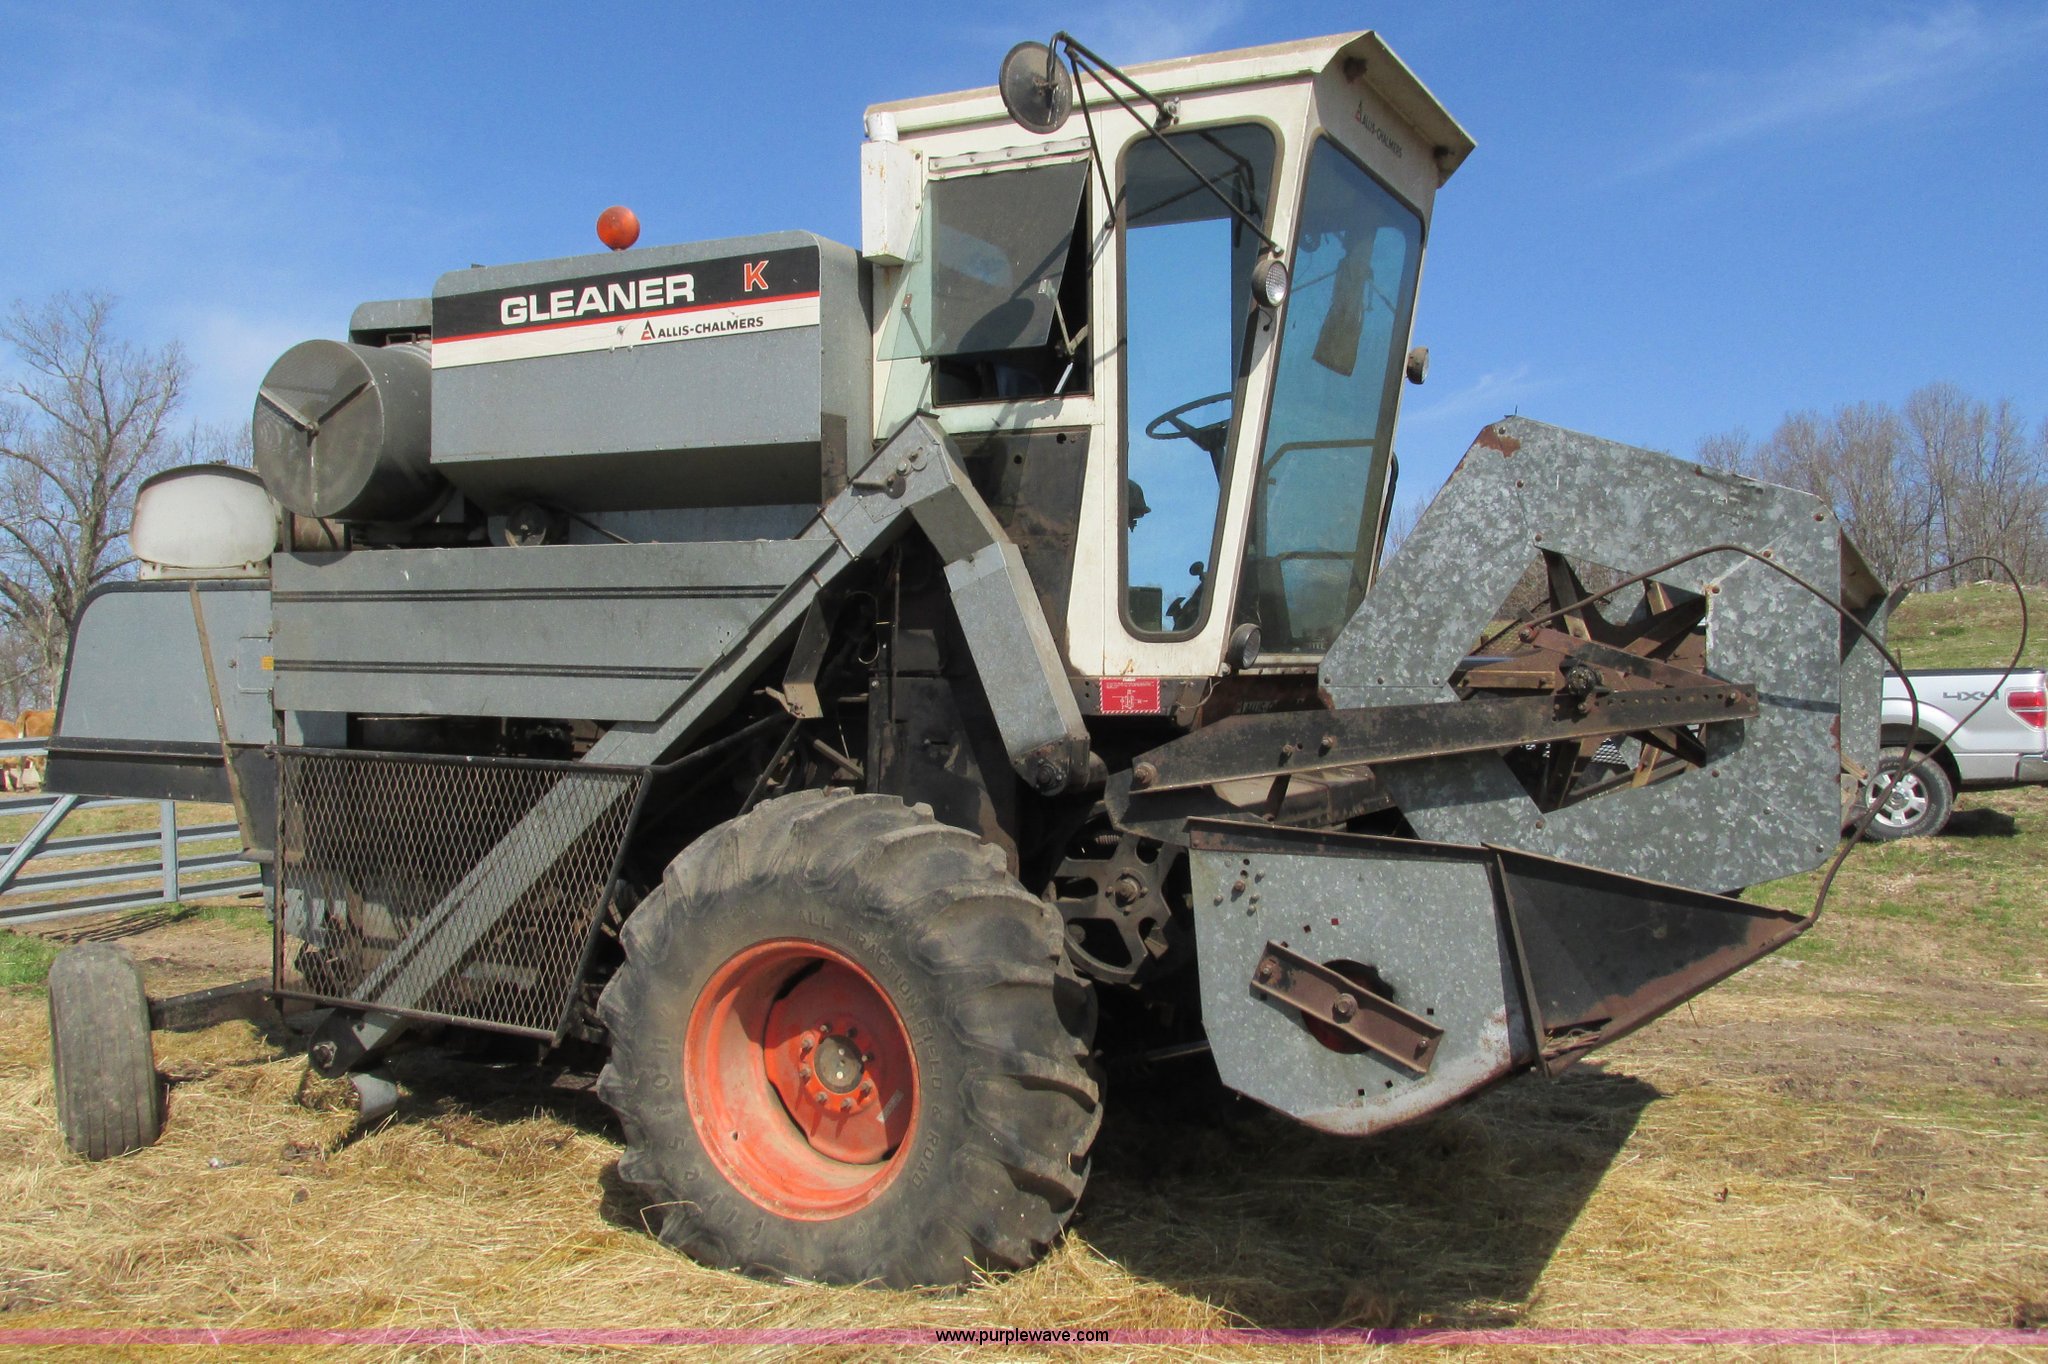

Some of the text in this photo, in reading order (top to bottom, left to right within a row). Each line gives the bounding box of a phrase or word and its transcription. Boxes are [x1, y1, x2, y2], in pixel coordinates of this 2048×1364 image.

[500, 260, 769, 326] GLEANER K
[657, 316, 764, 340] ALLIS-CHALMERS
[800, 910, 832, 931] ALL
[911, 1130, 941, 1189] ROAD
